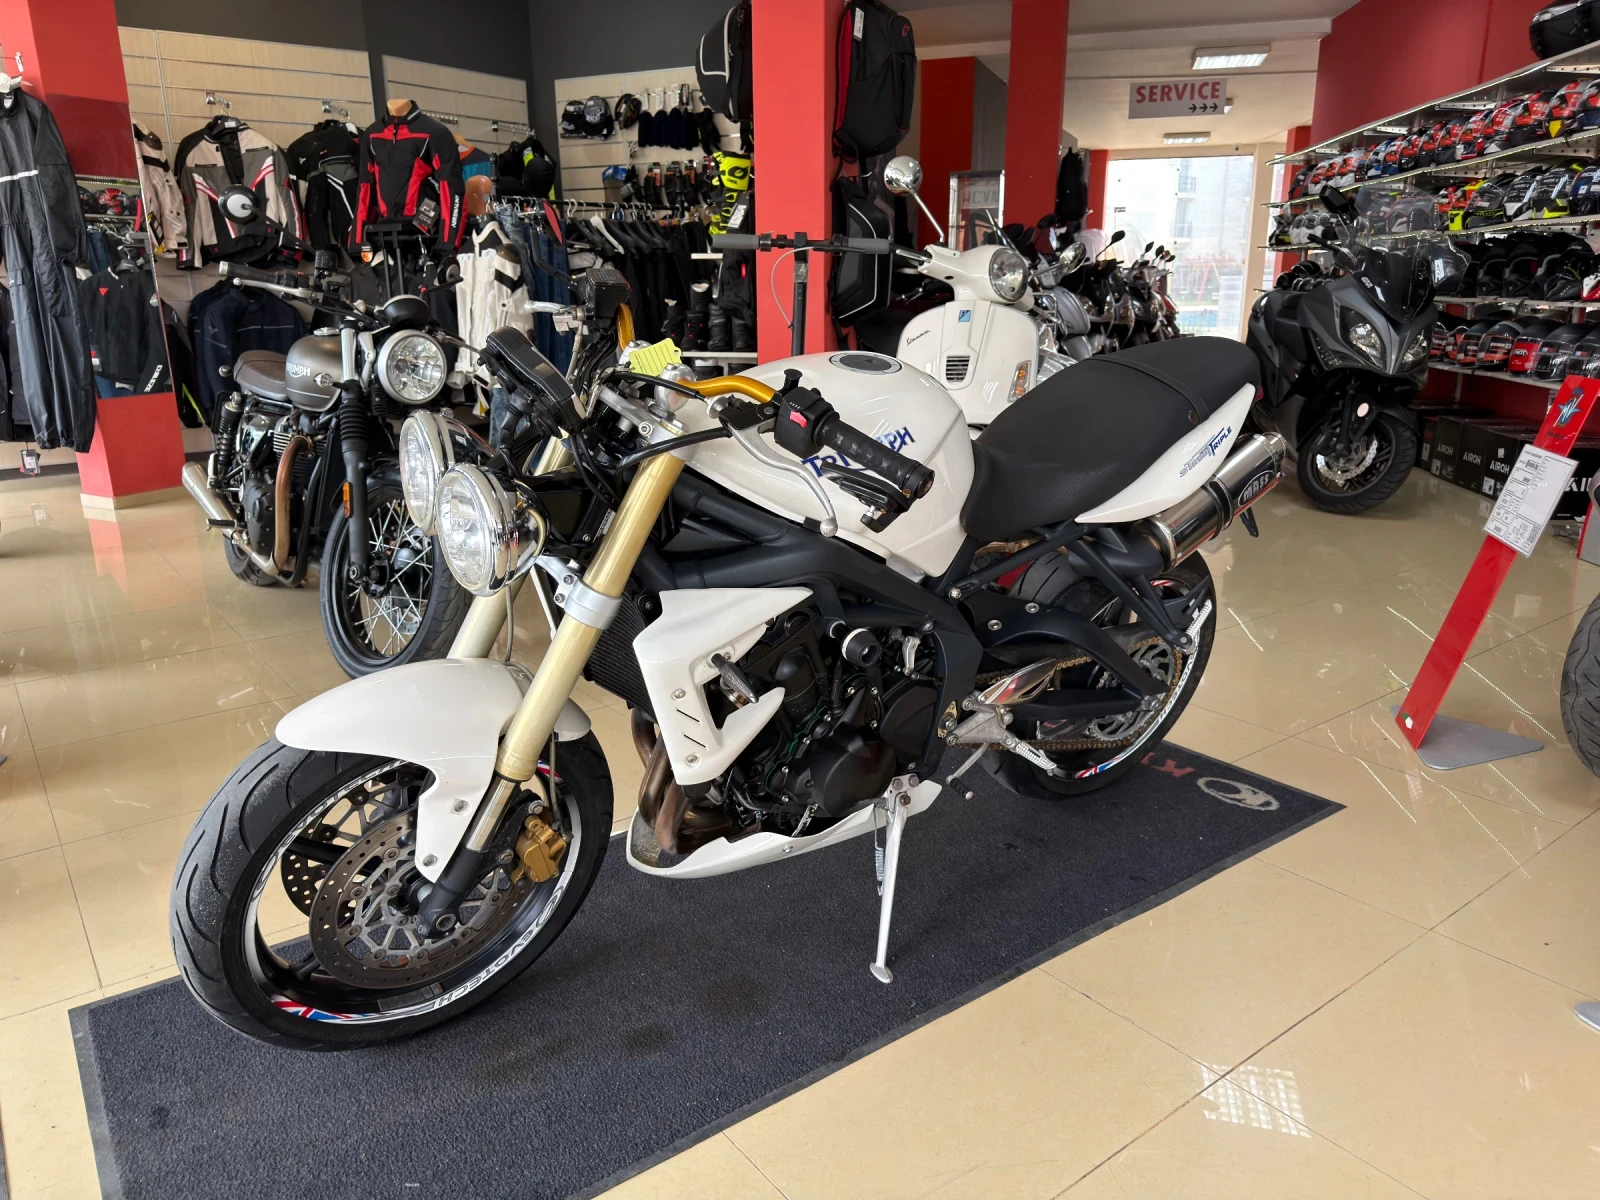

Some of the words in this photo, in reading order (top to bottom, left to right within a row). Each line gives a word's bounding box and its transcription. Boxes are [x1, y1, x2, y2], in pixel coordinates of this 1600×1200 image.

[1136, 82, 1221, 103] SERVICE
[1208, 426, 1233, 457] TRIPLE
[1437, 444, 1454, 456] AIROH
[1462, 451, 1481, 465] AIROH
[1489, 460, 1510, 475] AIROH
[437, 929, 534, 1007] EVOTECH
